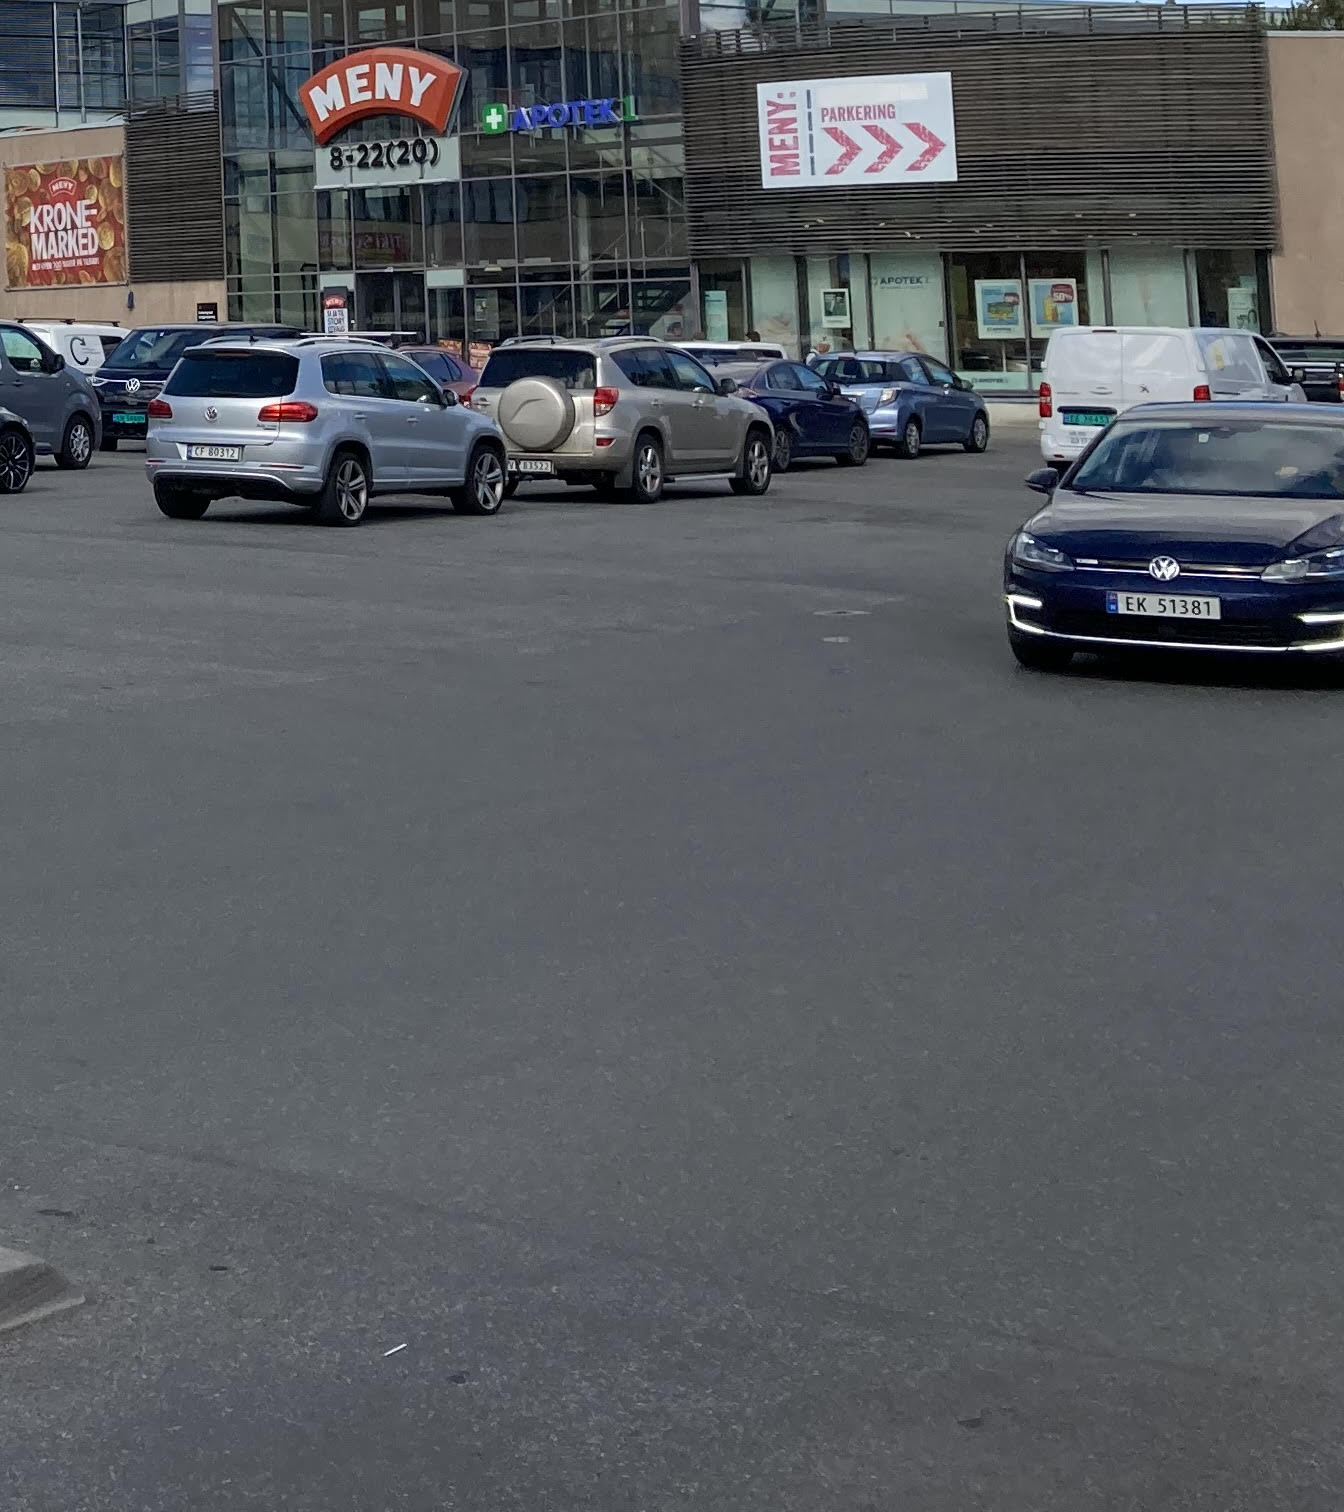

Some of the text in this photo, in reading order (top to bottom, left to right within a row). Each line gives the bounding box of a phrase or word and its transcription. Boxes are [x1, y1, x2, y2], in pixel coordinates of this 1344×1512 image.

[309, 63, 437, 122] MENY
[513, 97, 623, 132] APOTEK
[821, 103, 896, 123] PARKERING
[767, 91, 801, 177] MENY:
[330, 138, 439, 170] 8-22(20)
[29, 199, 97, 233] KRONE-
[31, 228, 100, 261] MARKED
[195, 447, 236, 458] CF 80312
[1125, 597, 1211, 616] EK 51381
